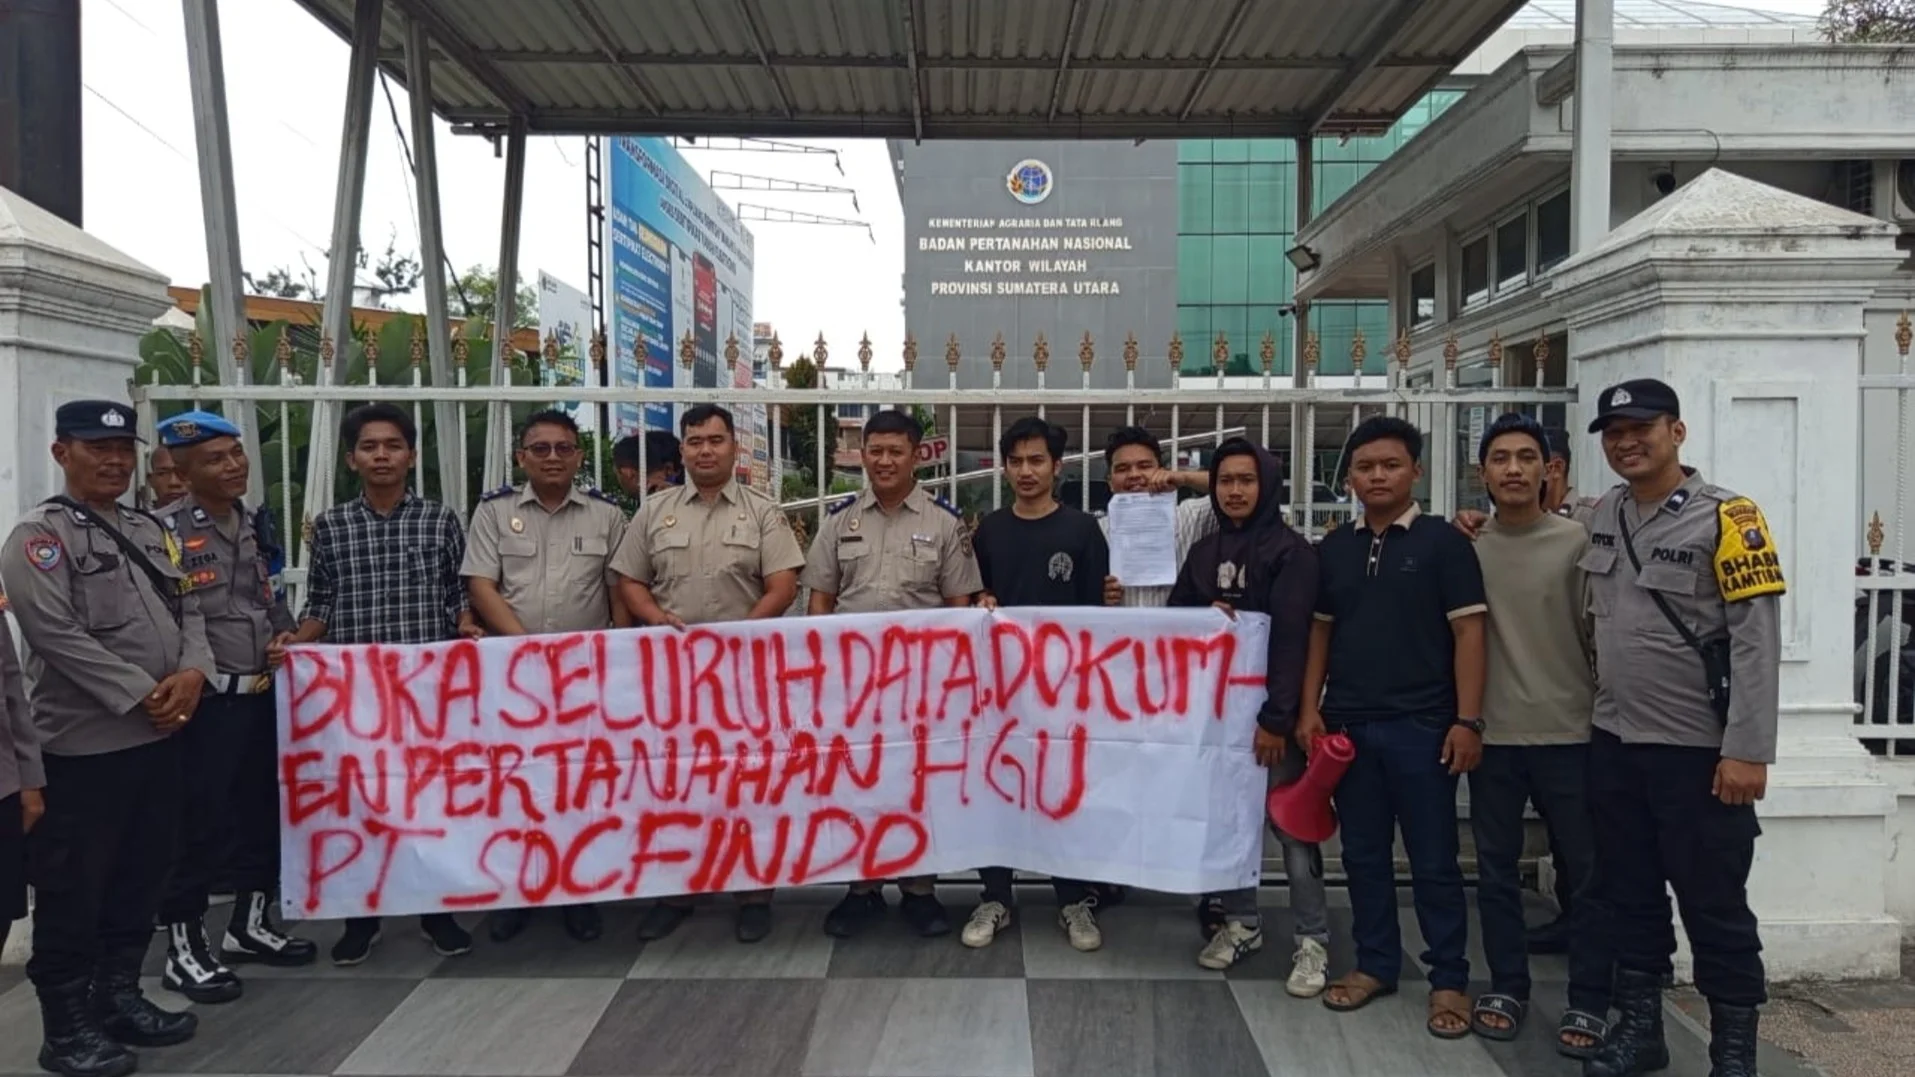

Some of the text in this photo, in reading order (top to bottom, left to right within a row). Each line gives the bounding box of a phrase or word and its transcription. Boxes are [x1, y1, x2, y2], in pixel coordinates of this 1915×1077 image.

[999, 217, 1041, 228] AGRARIA
[1043, 217, 1063, 228] DAN
[1065, 217, 1087, 228] TATA
[919, 237, 1132, 250] BADAN PERTANAHAN NASIONAL
[964, 259, 1087, 272] KANTOR WILAYAH
[931, 281, 1120, 295] PROVINSI SUMATERA UTARA
[1652, 547, 1693, 564] POLRI
[284, 640, 481, 743] BUKA
[499, 628, 824, 738] SELURUH
[909, 717, 1087, 821] HGU
[304, 807, 928, 912] PT SOCFINDO
